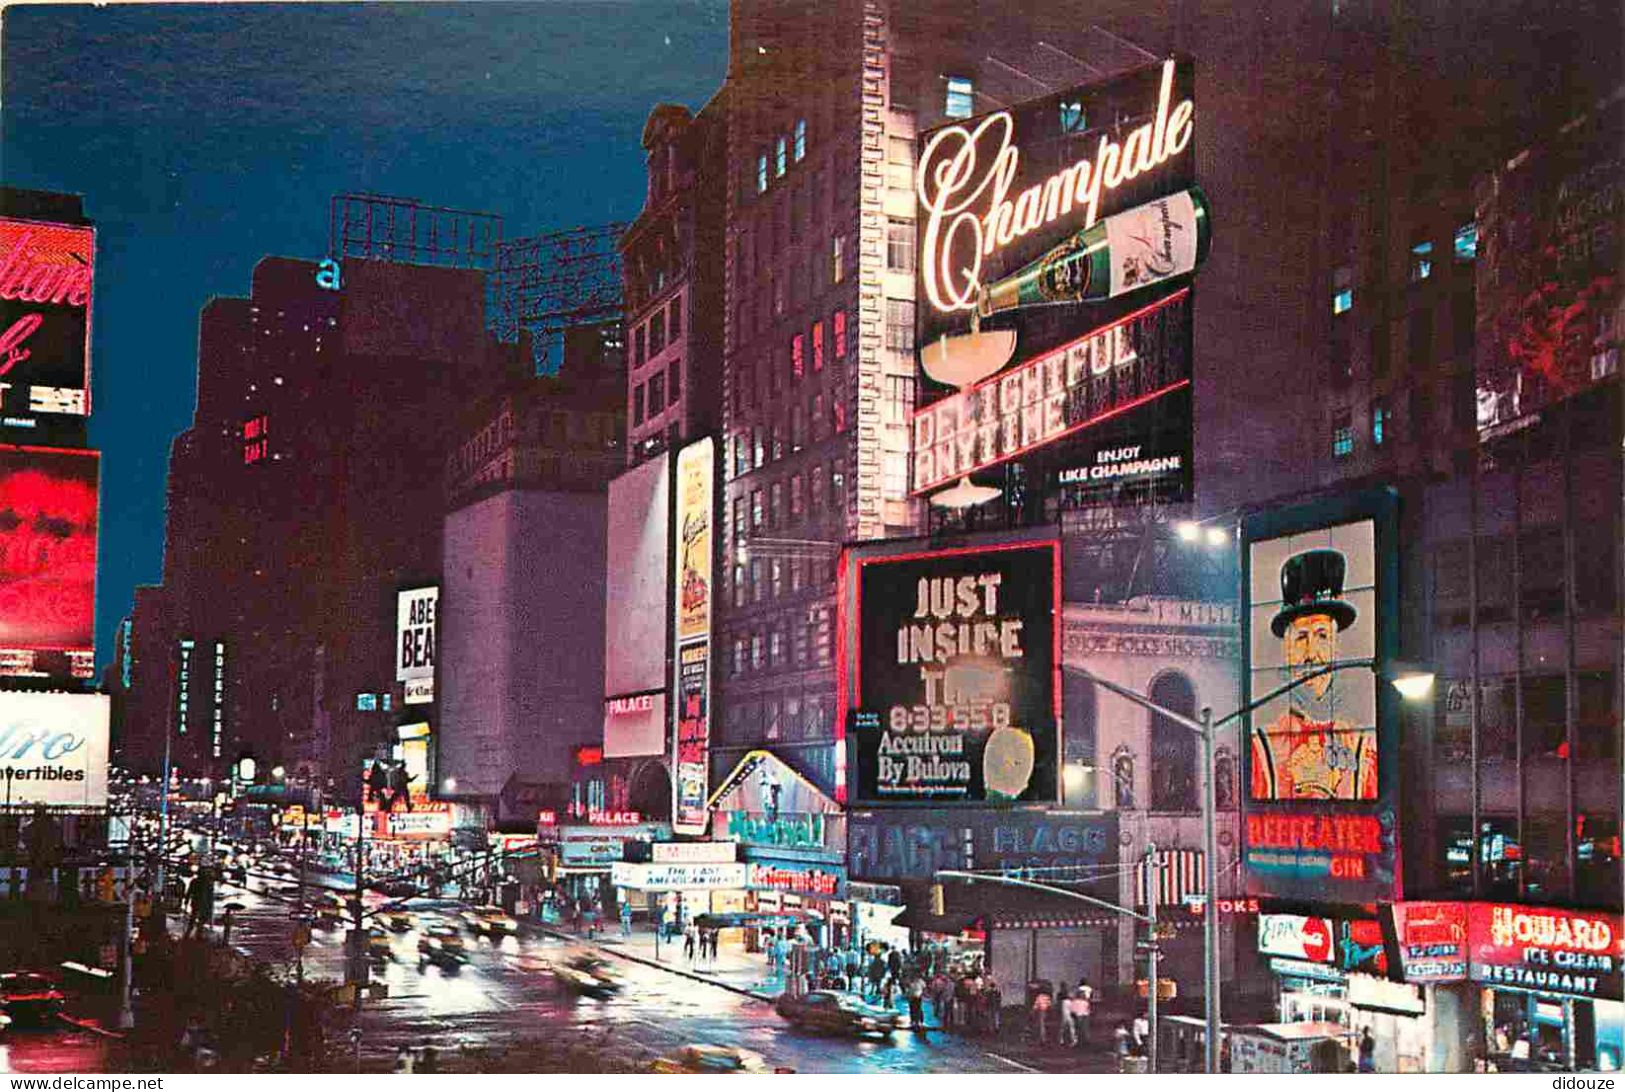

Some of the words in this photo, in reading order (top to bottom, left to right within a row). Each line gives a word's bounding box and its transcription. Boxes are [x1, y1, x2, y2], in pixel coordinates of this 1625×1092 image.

[918, 59, 1195, 311] Champale
[1097, 445, 1142, 463] ENJOY
[1059, 466, 1088, 483] LIKE
[1090, 456, 1182, 478] CHAMPAGNE
[914, 572, 1002, 618] JUST
[409, 597, 433, 625] ABE
[402, 626, 433, 668] BEA
[897, 618, 1024, 664] INSIDE
[179, 650, 190, 733] VICTORIA
[877, 730, 964, 755] Accutron
[877, 756, 905, 784] By
[906, 755, 971, 783] Bulova
[588, 811, 641, 824] PALACE
[1247, 814, 1381, 852] BEEFEATER
[1330, 856, 1363, 877] GIN
[1190, 900, 1260, 914] BOKS
[1492, 897, 1612, 951] HOWARD
[1523, 947, 1550, 964] ICE
[1555, 950, 1613, 974] CREAM
[1482, 963, 1599, 993] RESTAURANT
